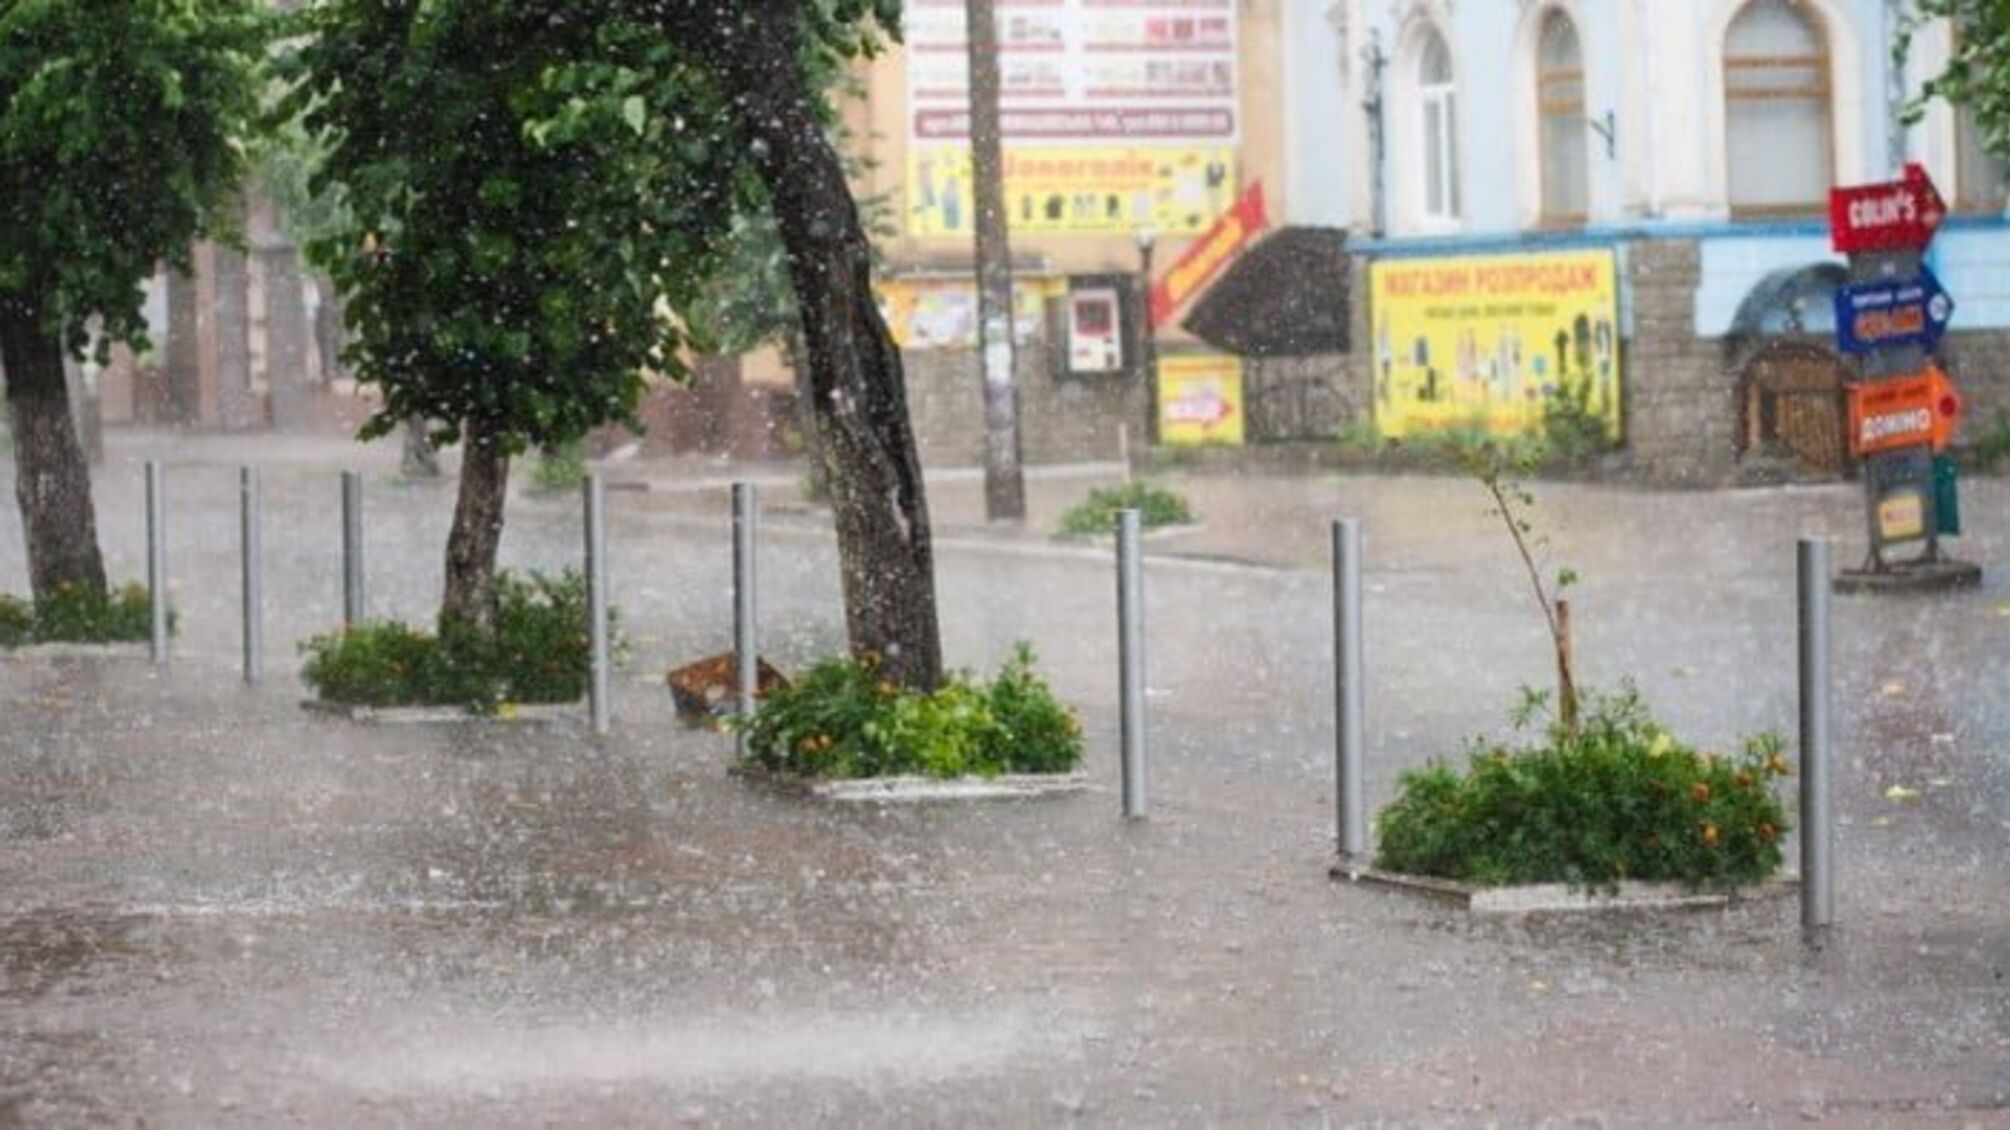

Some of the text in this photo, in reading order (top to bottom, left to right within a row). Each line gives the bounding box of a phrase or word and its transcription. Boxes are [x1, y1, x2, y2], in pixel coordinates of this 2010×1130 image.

[1848, 189, 1916, 229] COLIN'S
[1384, 262, 1597, 297] МАГАЗИН РОЗПРОДАЖ
